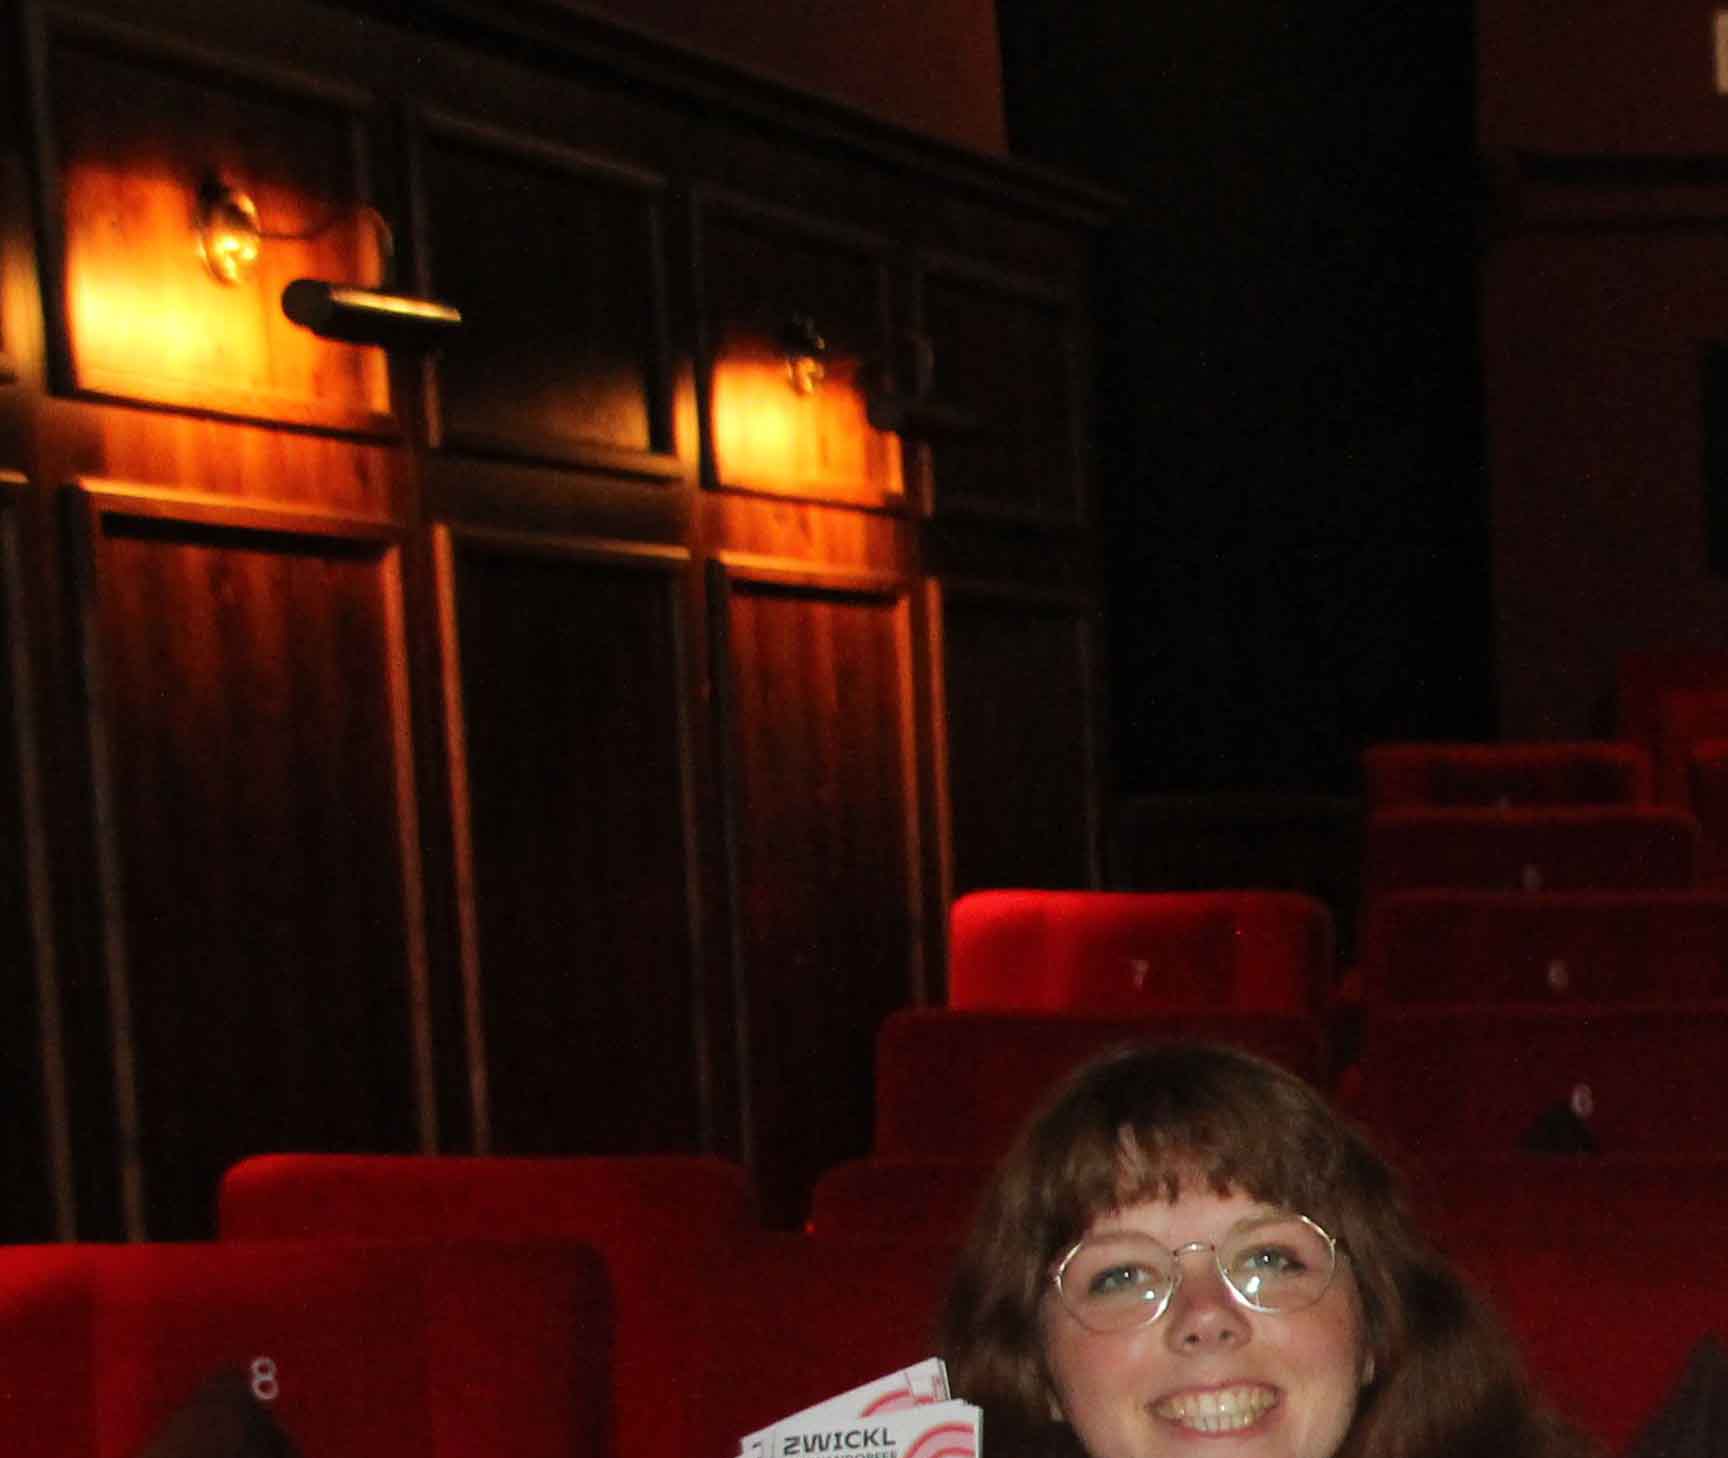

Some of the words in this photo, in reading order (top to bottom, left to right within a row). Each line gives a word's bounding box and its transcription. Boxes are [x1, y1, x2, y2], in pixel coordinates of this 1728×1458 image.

[1130, 959, 1149, 990] 7
[250, 1356, 279, 1401] 8
[783, 1427, 896, 1456] ZWICKL
